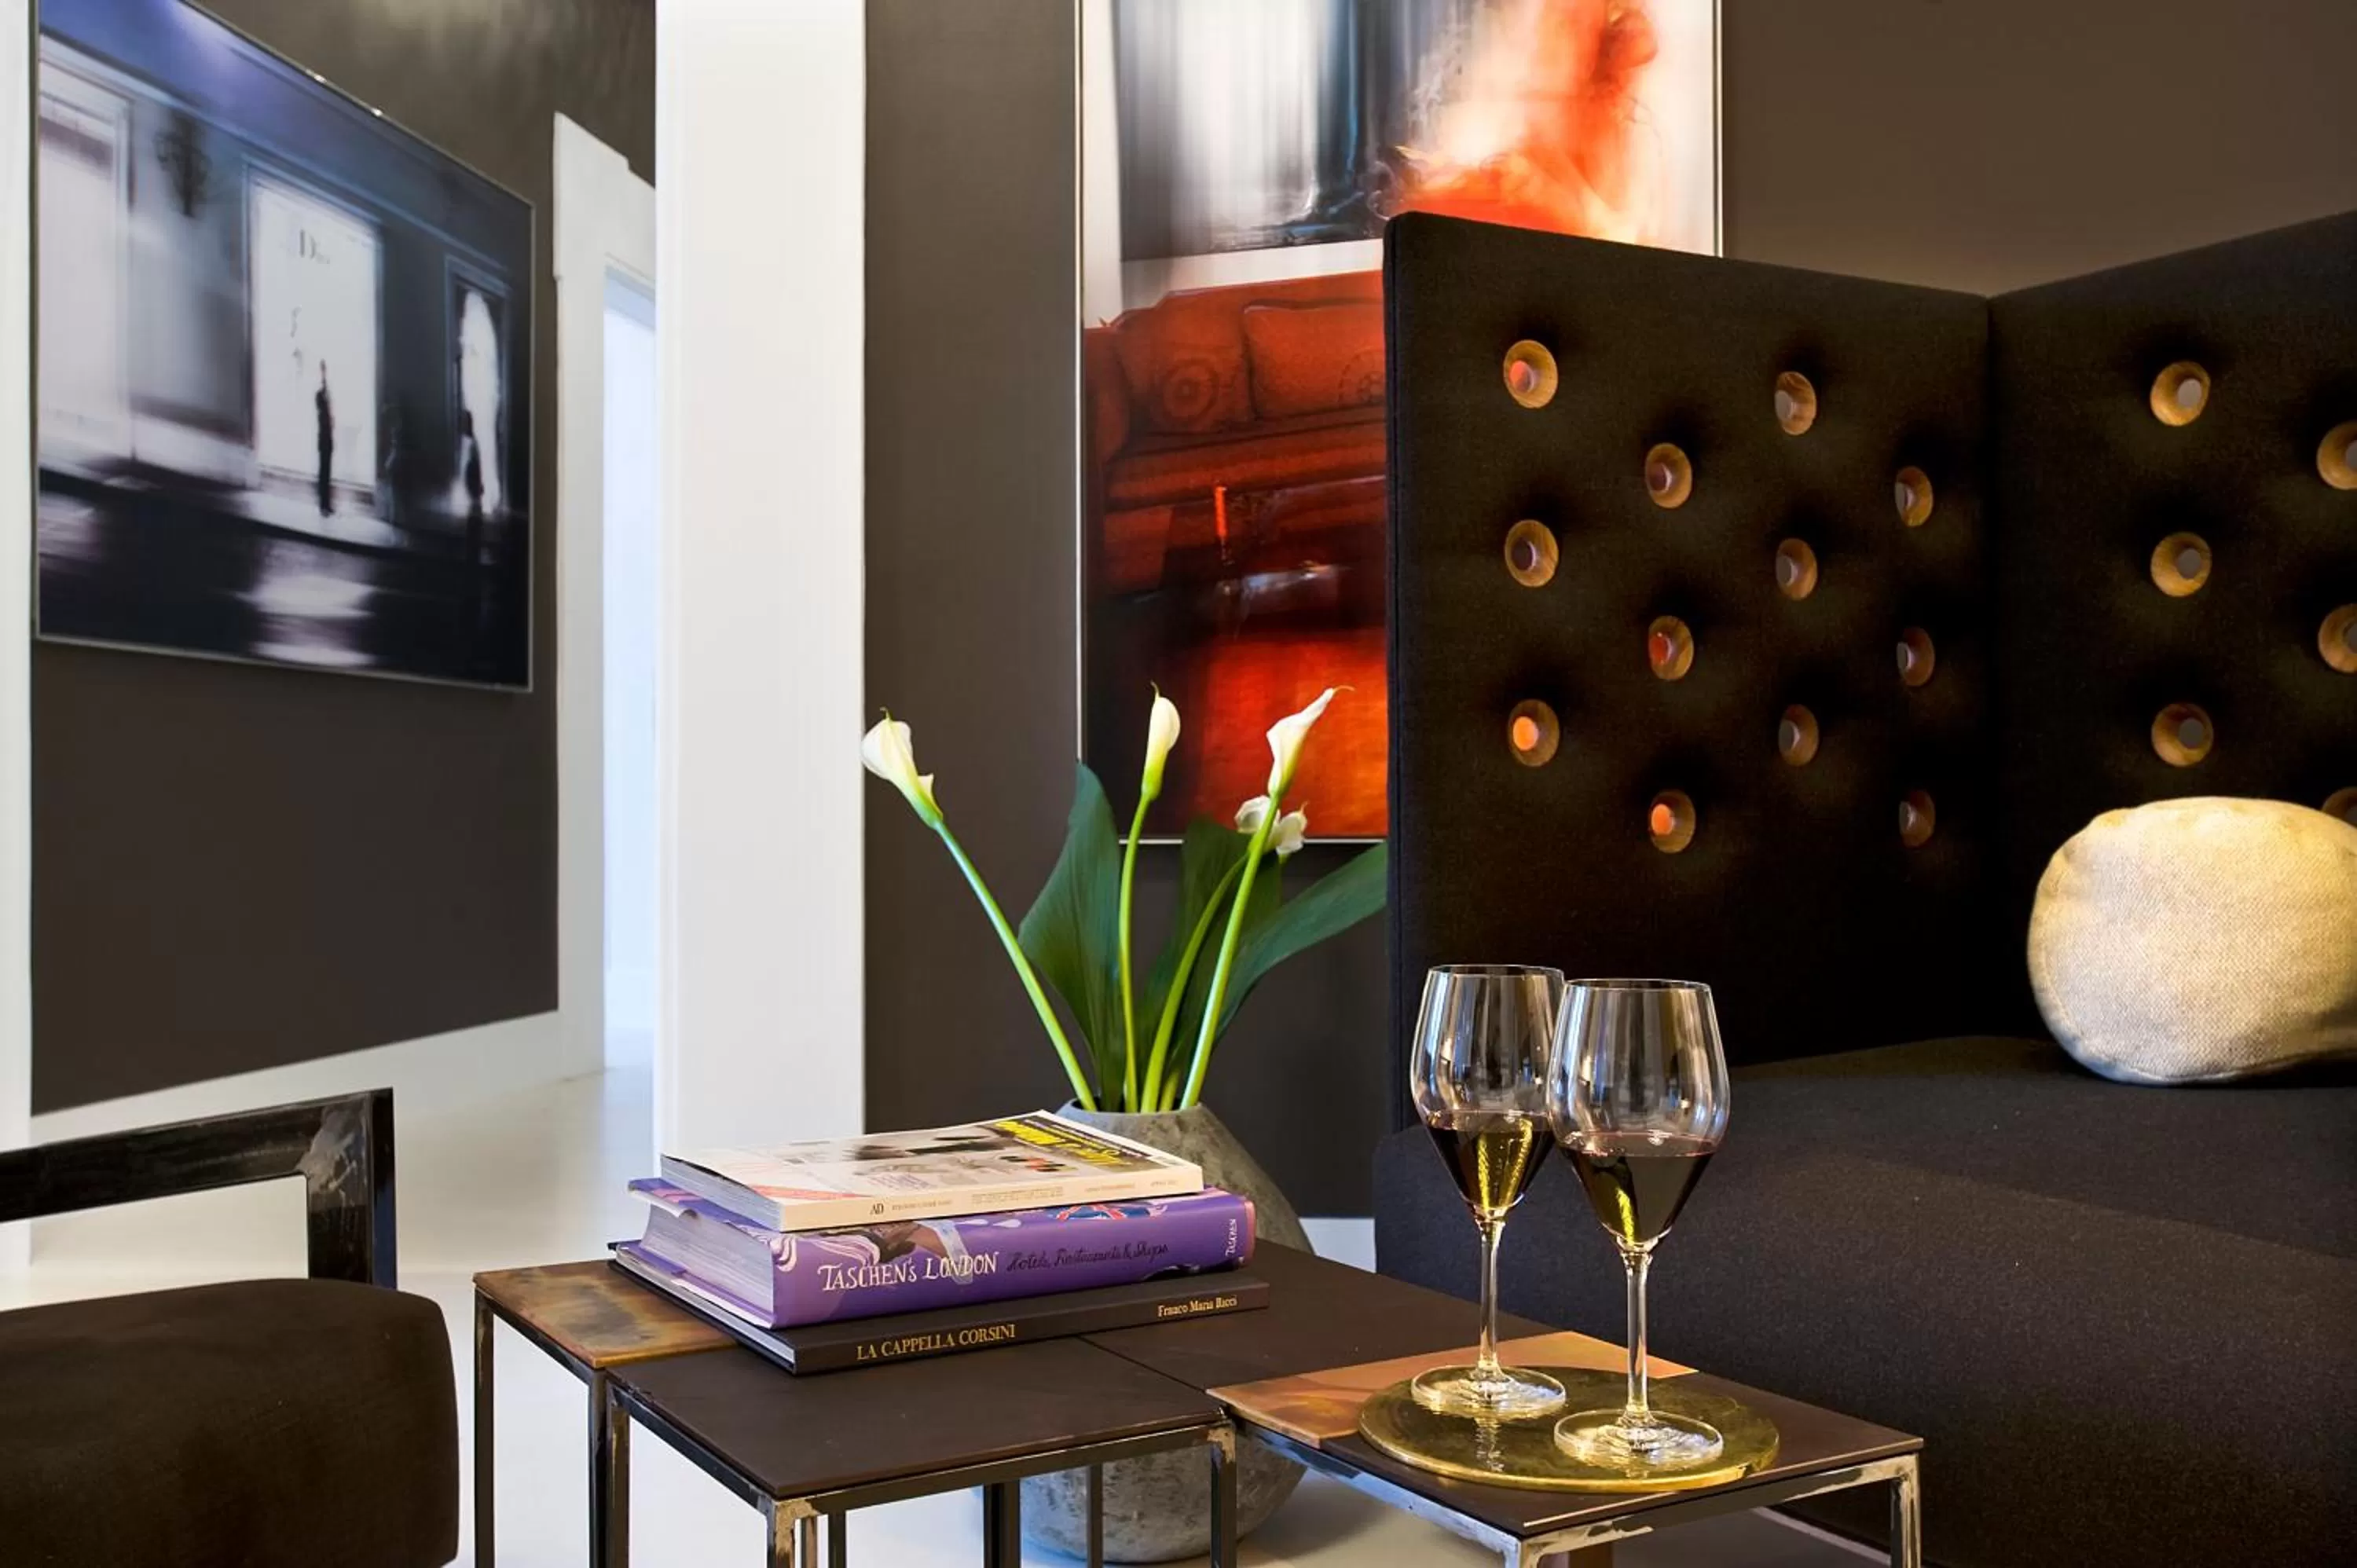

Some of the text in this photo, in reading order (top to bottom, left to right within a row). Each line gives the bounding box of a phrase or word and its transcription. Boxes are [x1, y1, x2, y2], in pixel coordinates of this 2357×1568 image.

[870, 1203, 885, 1215] AD
[922, 1251, 999, 1280] LONDON
[856, 1324, 1016, 1360] LA CAPPELLA CORSINI
